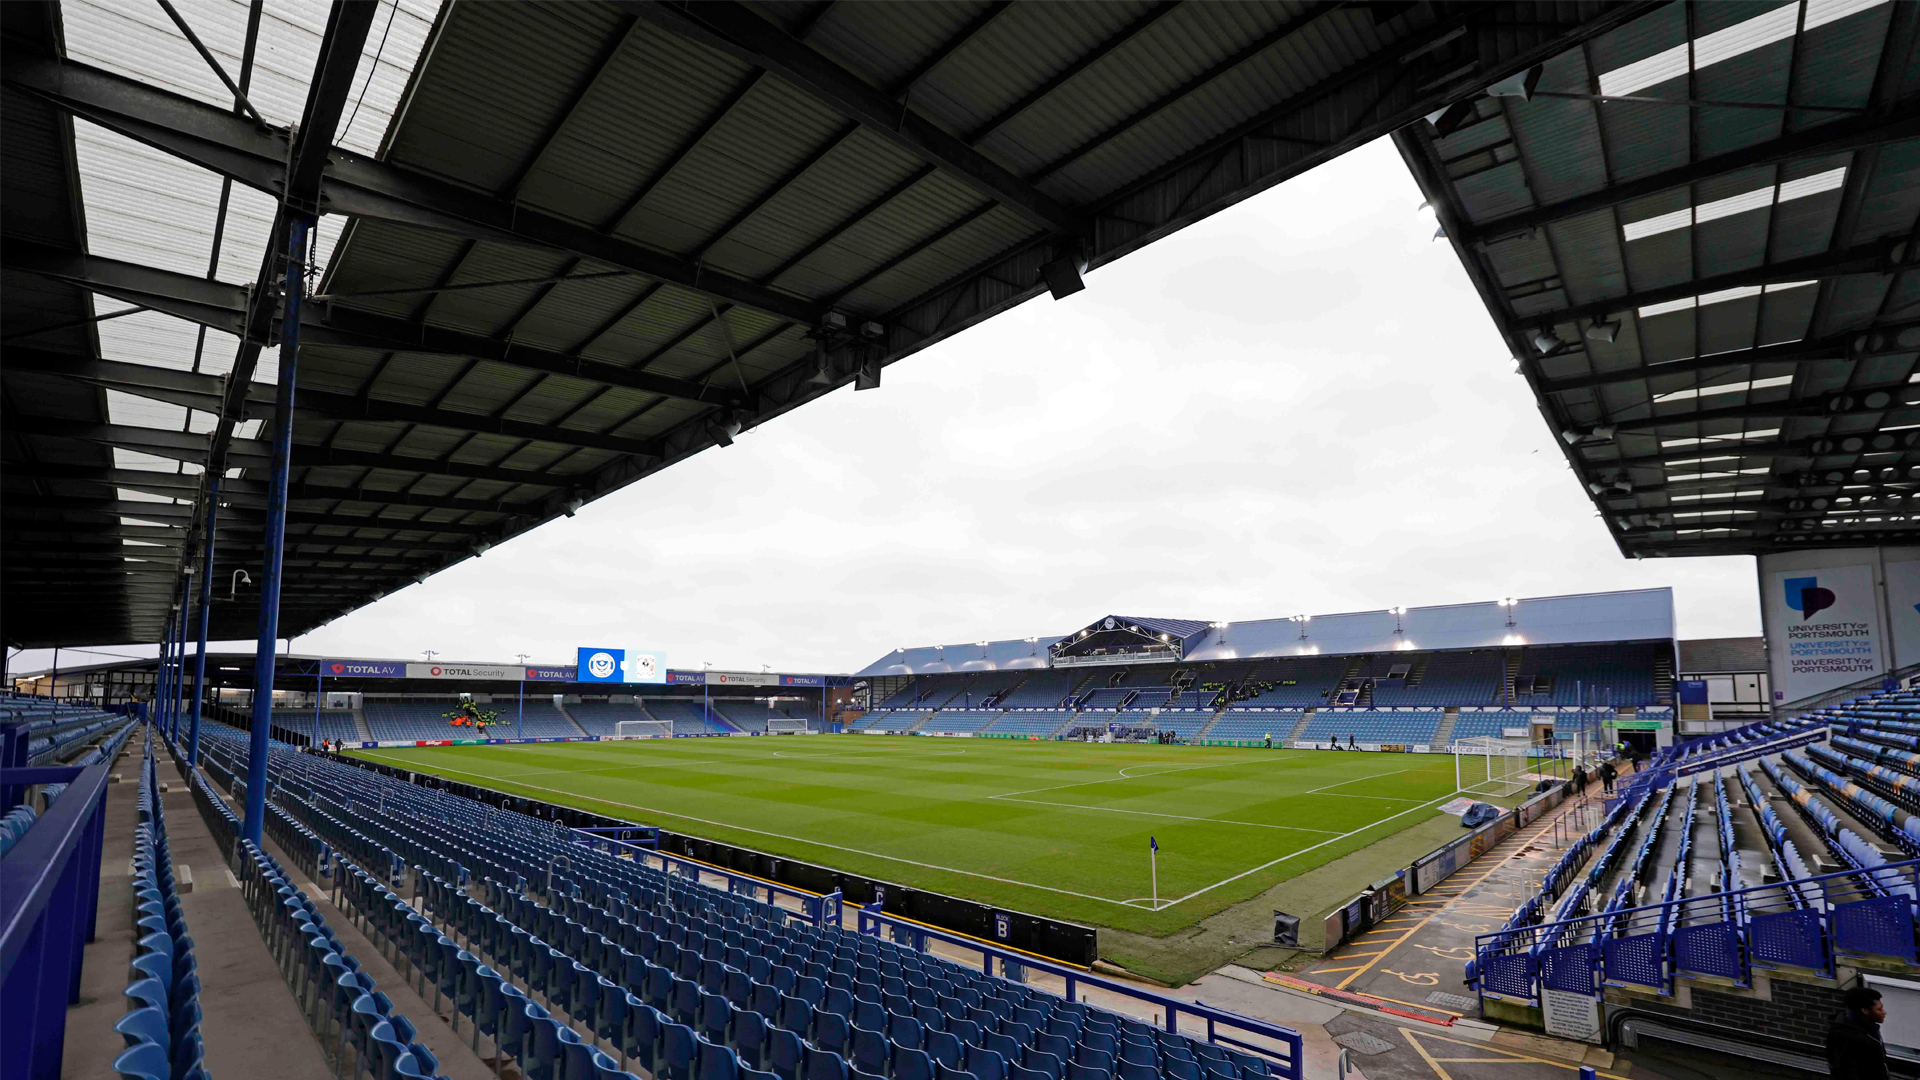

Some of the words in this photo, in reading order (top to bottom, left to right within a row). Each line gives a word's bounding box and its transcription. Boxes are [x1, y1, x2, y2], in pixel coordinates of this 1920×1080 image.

[1788, 622, 1857, 632] UNIVERSITY
[1789, 629, 1869, 639] PORTSMOUTH
[1790, 640, 1859, 649] UNIVERSITY
[1791, 647, 1871, 656] PORTSMOUTH
[1791, 657, 1861, 666] UNIVERSITY
[346, 665, 381, 674] TOTAL
[381, 666, 396, 674] AV
[443, 668, 471, 676] TOTAL
[472, 669, 505, 677] Security
[1793, 665, 1873, 673] PORTSMOUTH
[538, 670, 564, 678] TOTAL
[564, 671, 575, 679] AV
[876, 891, 884, 906] C
[997, 920, 1008, 938] B
